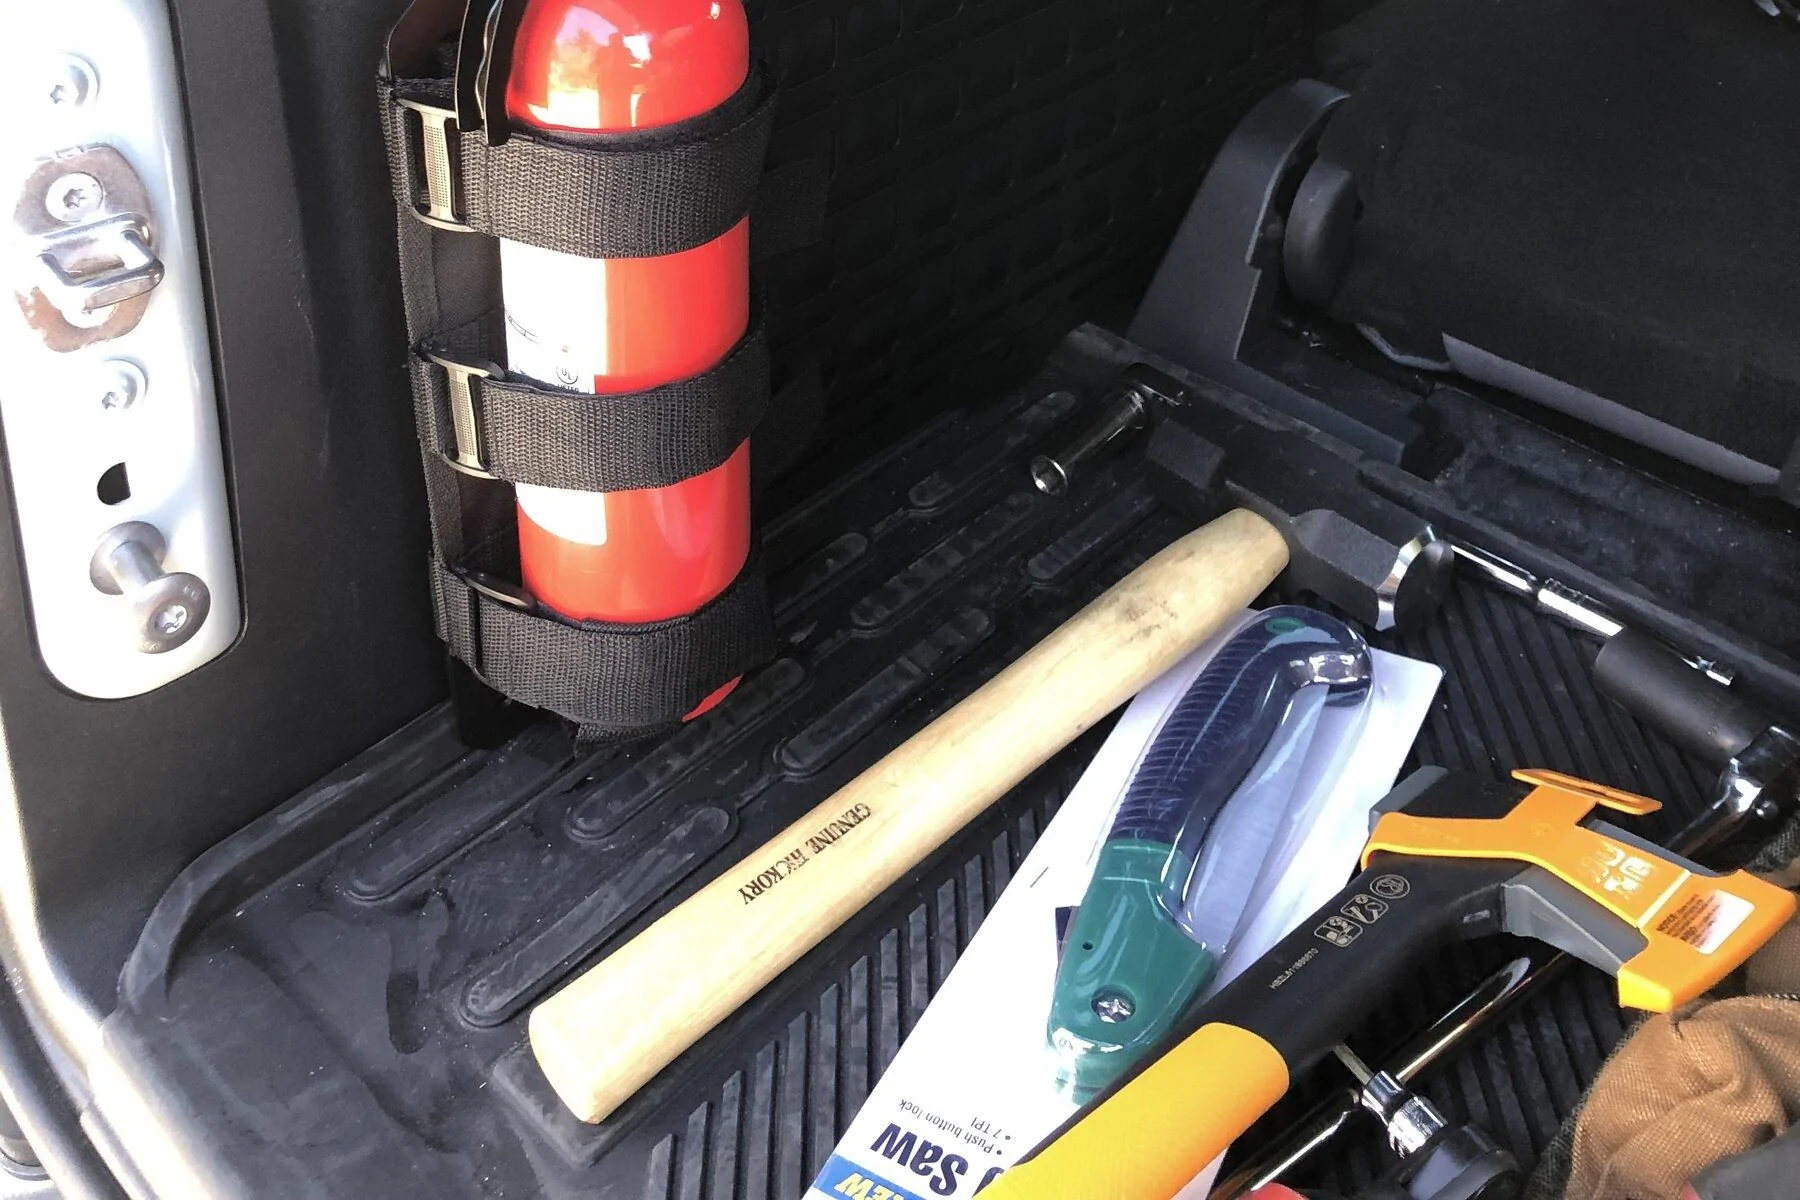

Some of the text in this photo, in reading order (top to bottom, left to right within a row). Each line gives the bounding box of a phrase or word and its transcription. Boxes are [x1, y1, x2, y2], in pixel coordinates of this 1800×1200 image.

[738, 802, 872, 905] GENUINE HICKORY
[899, 1098, 994, 1154] Push button lock
[970, 1116, 1003, 1139] 7 TPI
[834, 1173, 905, 1200] EW
[869, 1122, 969, 1196] Saw
